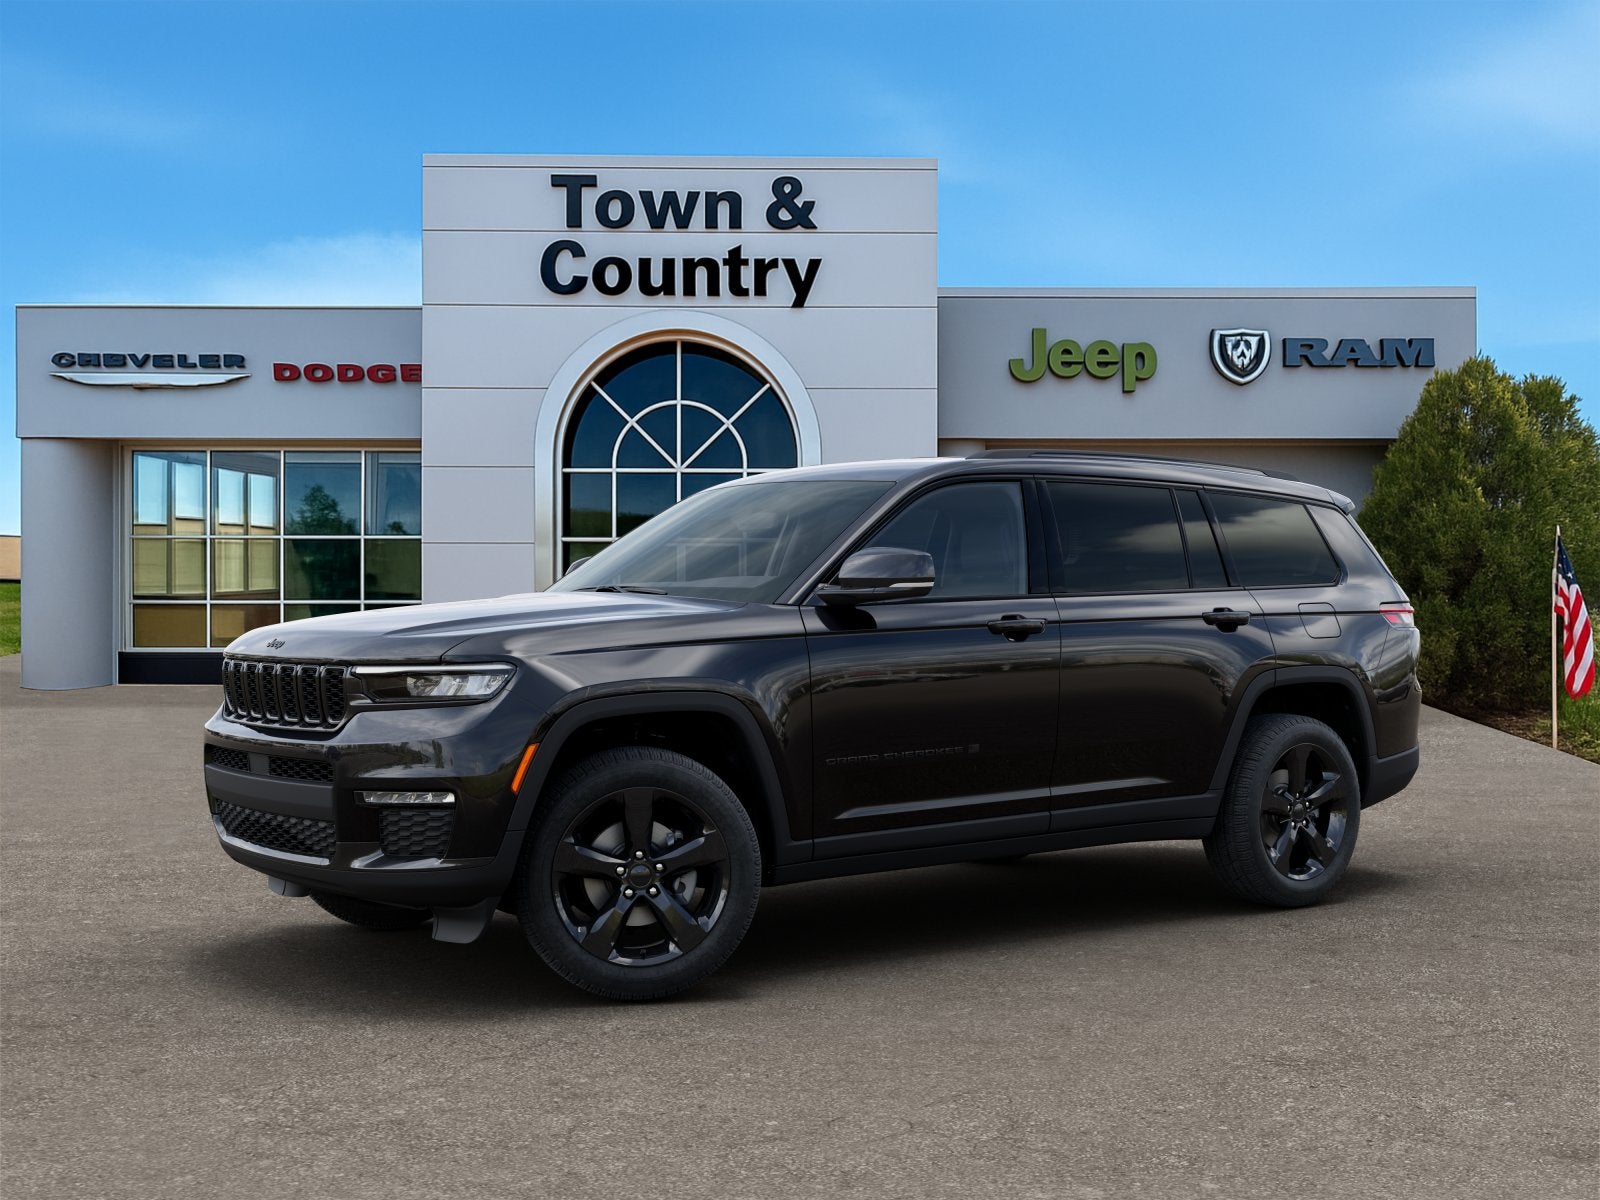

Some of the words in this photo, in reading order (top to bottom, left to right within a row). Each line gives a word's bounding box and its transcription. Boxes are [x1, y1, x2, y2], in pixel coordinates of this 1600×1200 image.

[550, 174, 743, 230] Town
[765, 176, 818, 230] &
[540, 239, 823, 308] Country
[273, 362, 422, 383] DODGE
[1008, 327, 1158, 393] Jeep
[1282, 337, 1436, 368] RAM
